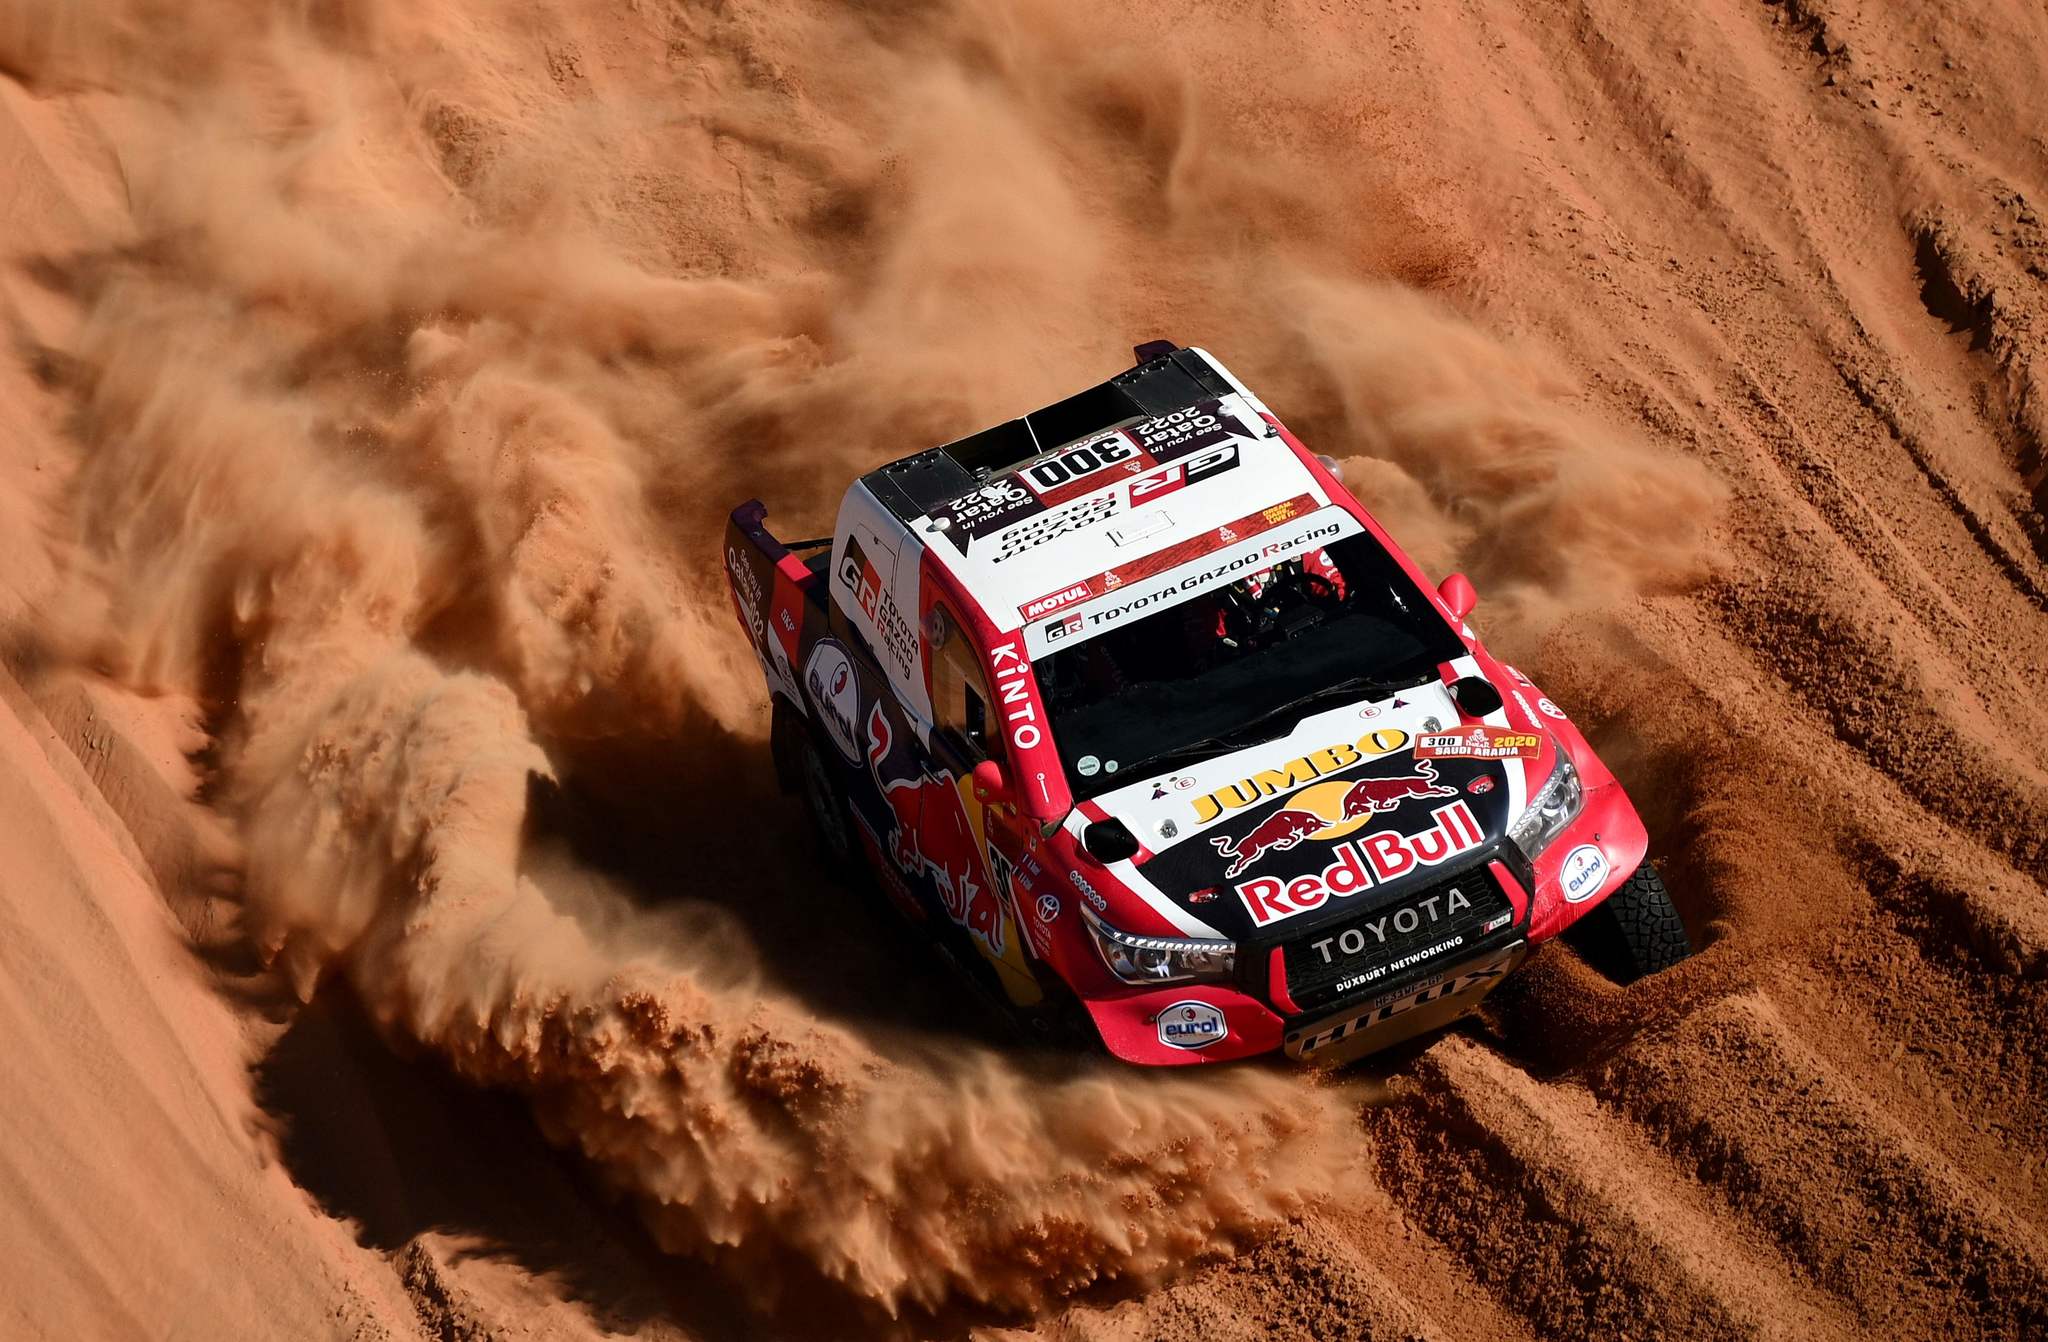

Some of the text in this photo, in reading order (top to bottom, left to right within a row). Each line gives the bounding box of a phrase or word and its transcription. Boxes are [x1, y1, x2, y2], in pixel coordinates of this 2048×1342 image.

[1135, 406, 1200, 435] 2022
[1144, 414, 1216, 447] Qatar
[1166, 432, 1193, 447] you
[1196, 423, 1223, 436] See
[1029, 437, 1132, 487] 300
[1132, 446, 1237, 497] GR
[948, 479, 1012, 511] 222
[956, 487, 1027, 523] Qatar
[978, 506, 1004, 523] you
[1002, 491, 1115, 542] Racing
[1007, 496, 1034, 510] See
[992, 510, 1120, 564] TOYOTA
[1001, 500, 1117, 551] GAZOO
[839, 555, 879, 620] GR
[1026, 584, 1088, 618] MOTUL
[1047, 522, 1341, 643] GR TOYOTA GAZOO Racing
[879, 604, 914, 665] GAZOO
[883, 587, 919, 656] TOYOTA
[876, 617, 911, 681] Racing
[1427, 737, 1456, 746] 300
[1434, 746, 1519, 757] SAUDI ARABIA
[1493, 735, 1537, 748] 2020
[1190, 728, 1410, 825] JUMBO
[1239, 802, 1483, 924] Red Bull
[1568, 855, 1601, 892] eurol
[1311, 887, 1471, 964] TOYOTA
[1335, 935, 1464, 993] DUXBURY NETWORKING
[1165, 1016, 1218, 1036] eurol
[1299, 958, 1510, 1055] HILUX
